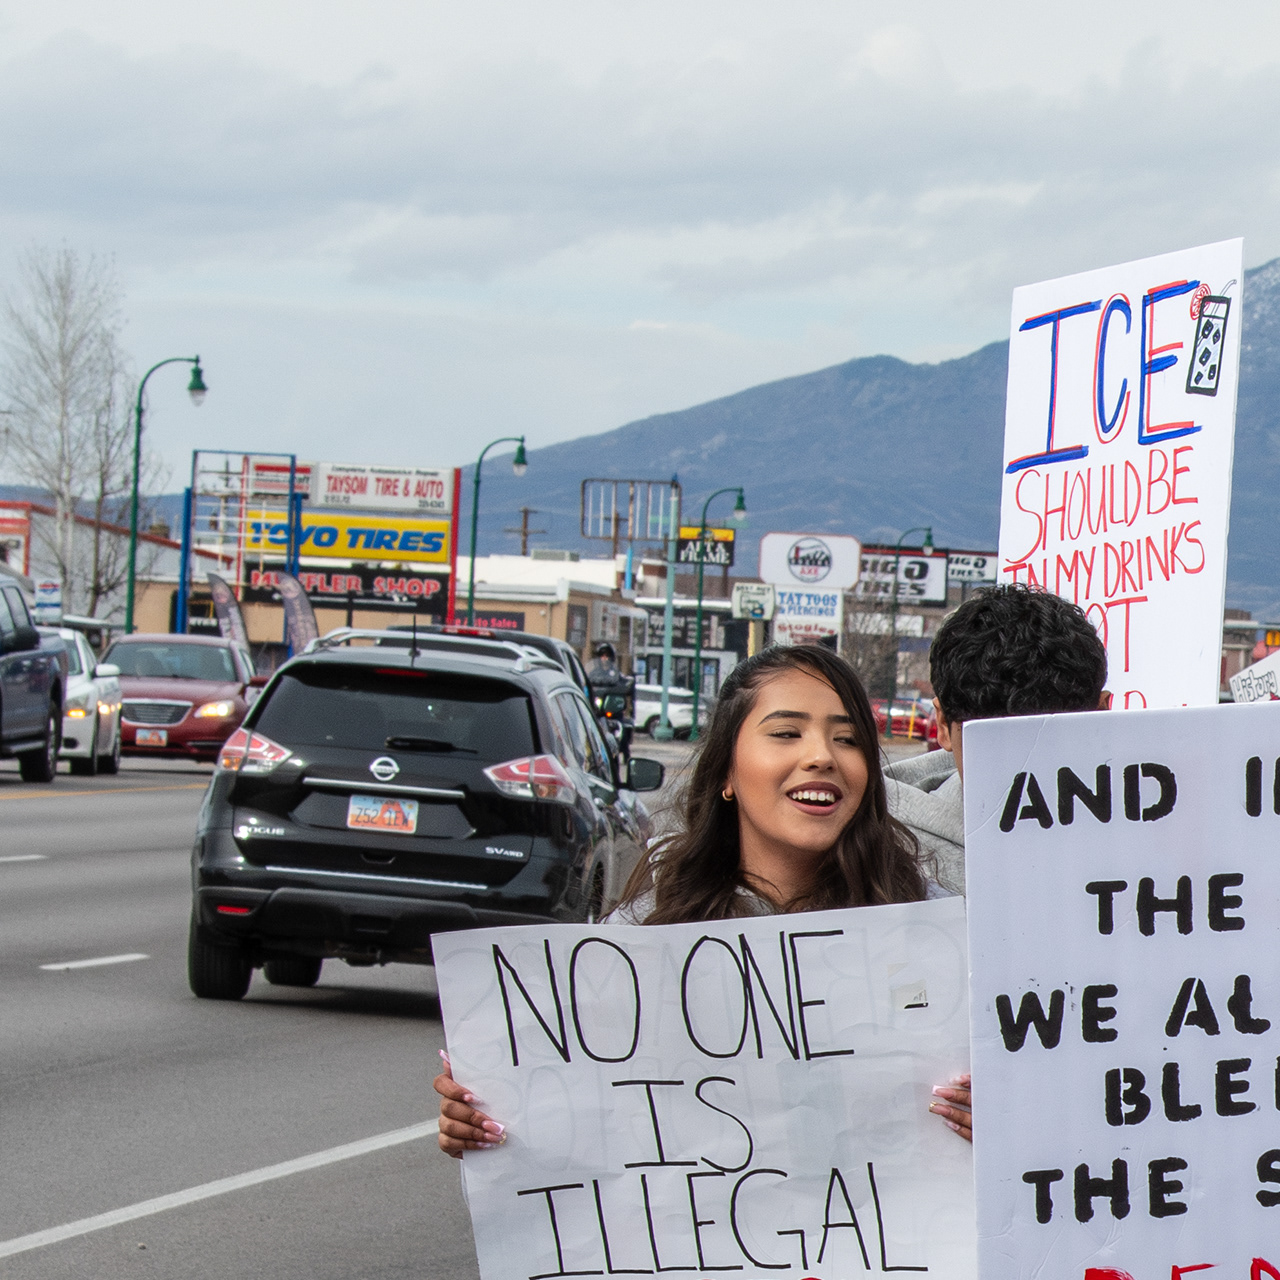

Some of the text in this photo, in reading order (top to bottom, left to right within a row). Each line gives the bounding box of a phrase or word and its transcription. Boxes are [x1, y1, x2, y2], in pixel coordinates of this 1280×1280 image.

[1005, 280, 1203, 474] ICE
[326, 474, 368, 495] TAYSOM
[375, 477, 399, 496] TIRE
[403, 480, 410, 498] &
[415, 480, 444, 499] AUTO
[1006, 445, 1199, 564] SHOULD BE
[347, 527, 445, 552] TIRES
[1057, 545, 1097, 607] MY
[1104, 520, 1206, 599] DRINKS
[373, 576, 441, 597] SHOP
[777, 591, 838, 607] TATTOOS
[788, 605, 836, 617] PIERCINGS
[490, 617, 518, 629] Sales
[1085, 594, 1149, 673] OT
[999, 761, 1179, 833] AND
[1085, 872, 1247, 937] THE
[493, 936, 641, 1067] NO
[681, 929, 855, 1062] ONE
[995, 984, 1120, 1053] WE
[612, 1076, 754, 1173] IS
[517, 1162, 929, 1280] ILLEGAL
[1021, 1156, 1190, 1225] THE
